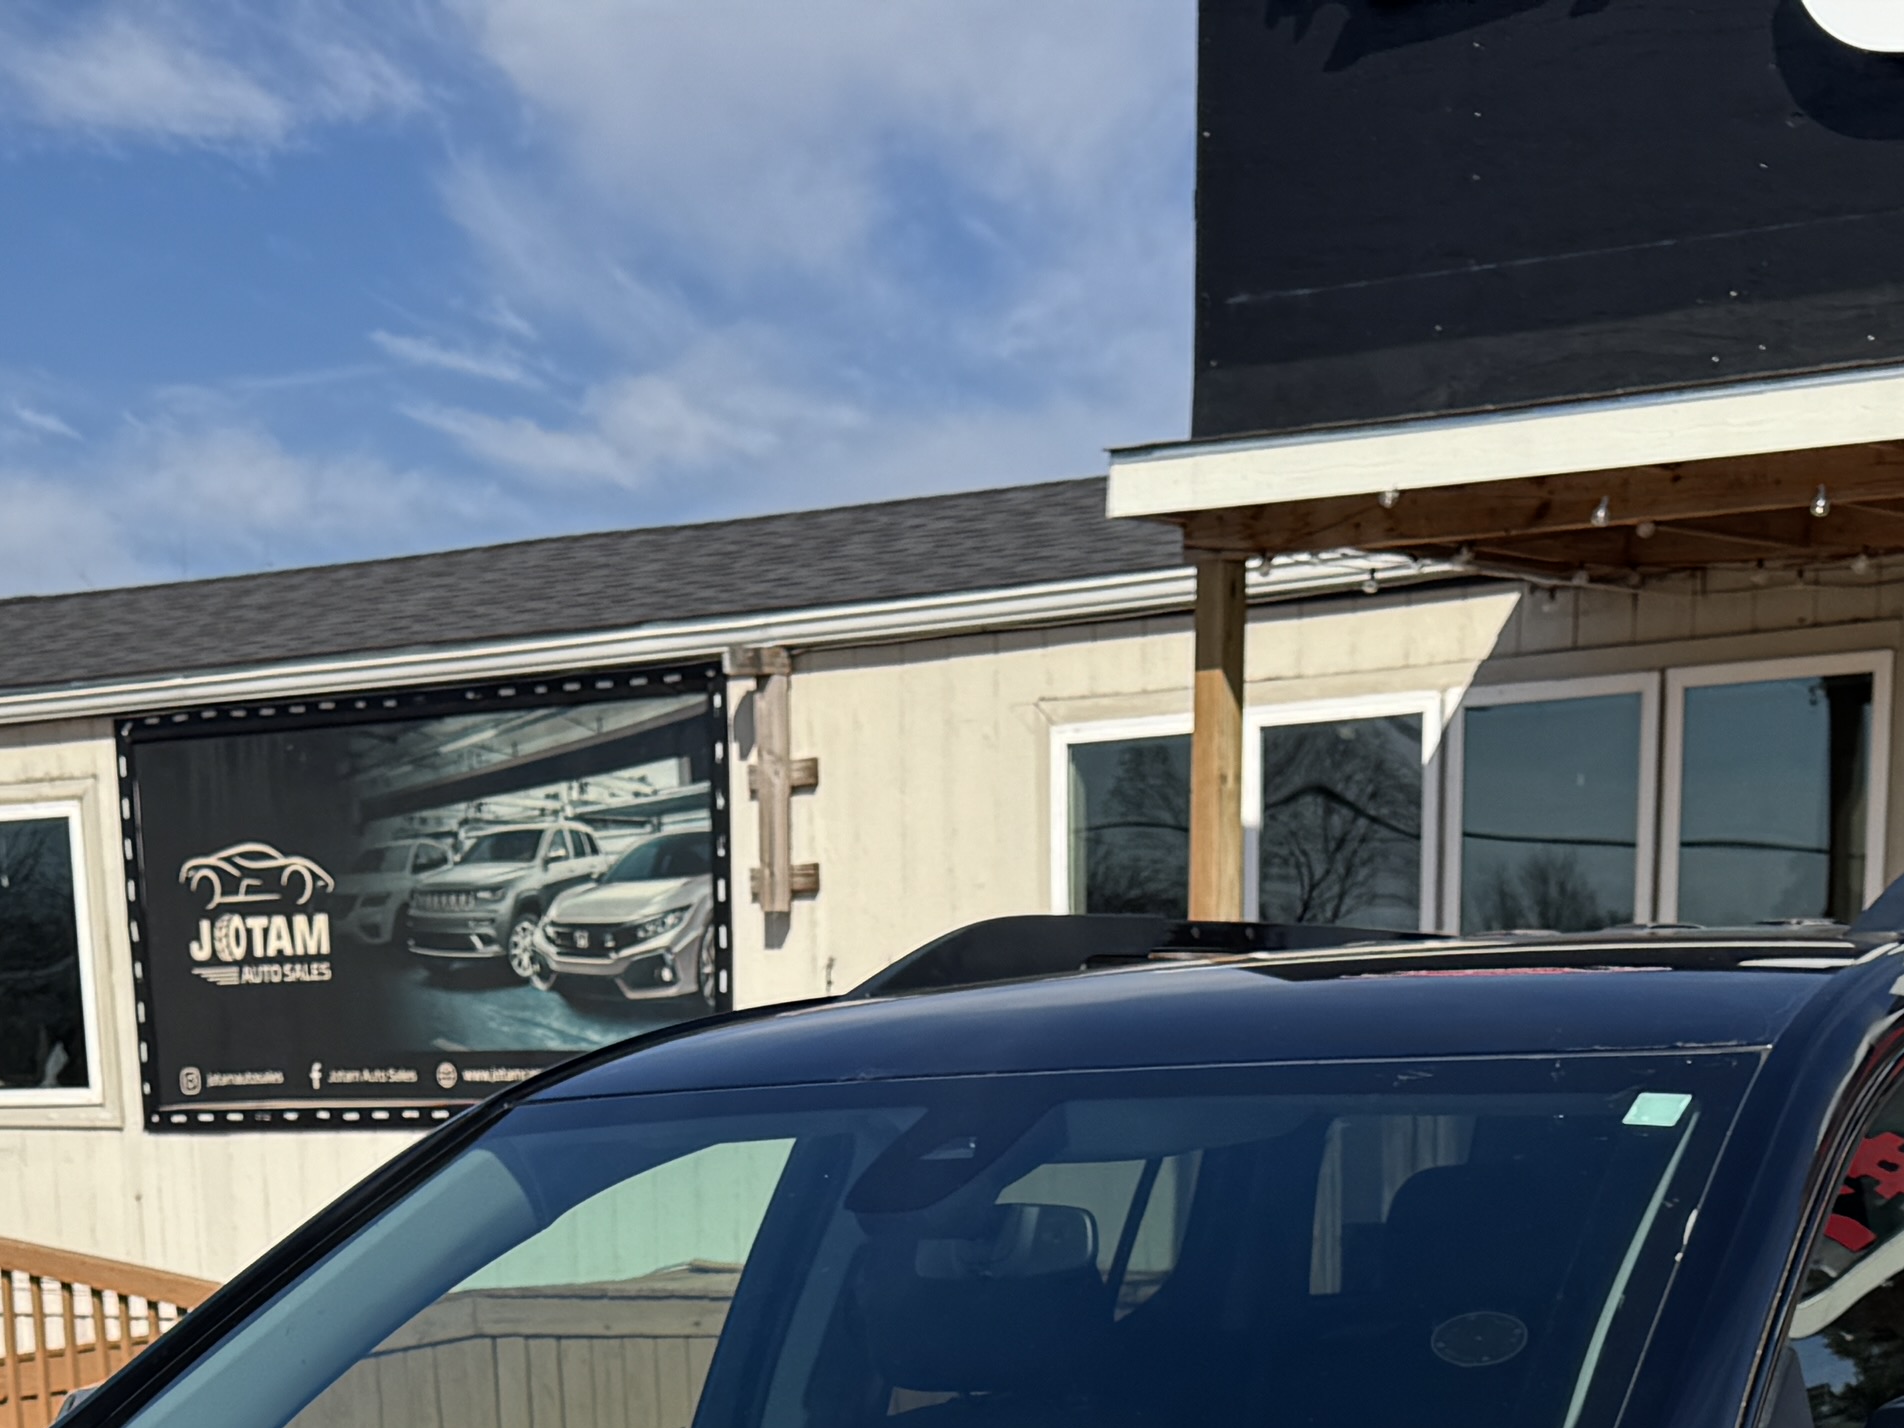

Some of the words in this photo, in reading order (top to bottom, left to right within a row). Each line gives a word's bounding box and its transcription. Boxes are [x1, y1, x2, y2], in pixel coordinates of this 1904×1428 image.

[189, 912, 331, 962] JOTAM
[241, 962, 283, 984] AUTO
[283, 961, 332, 983] SALES
